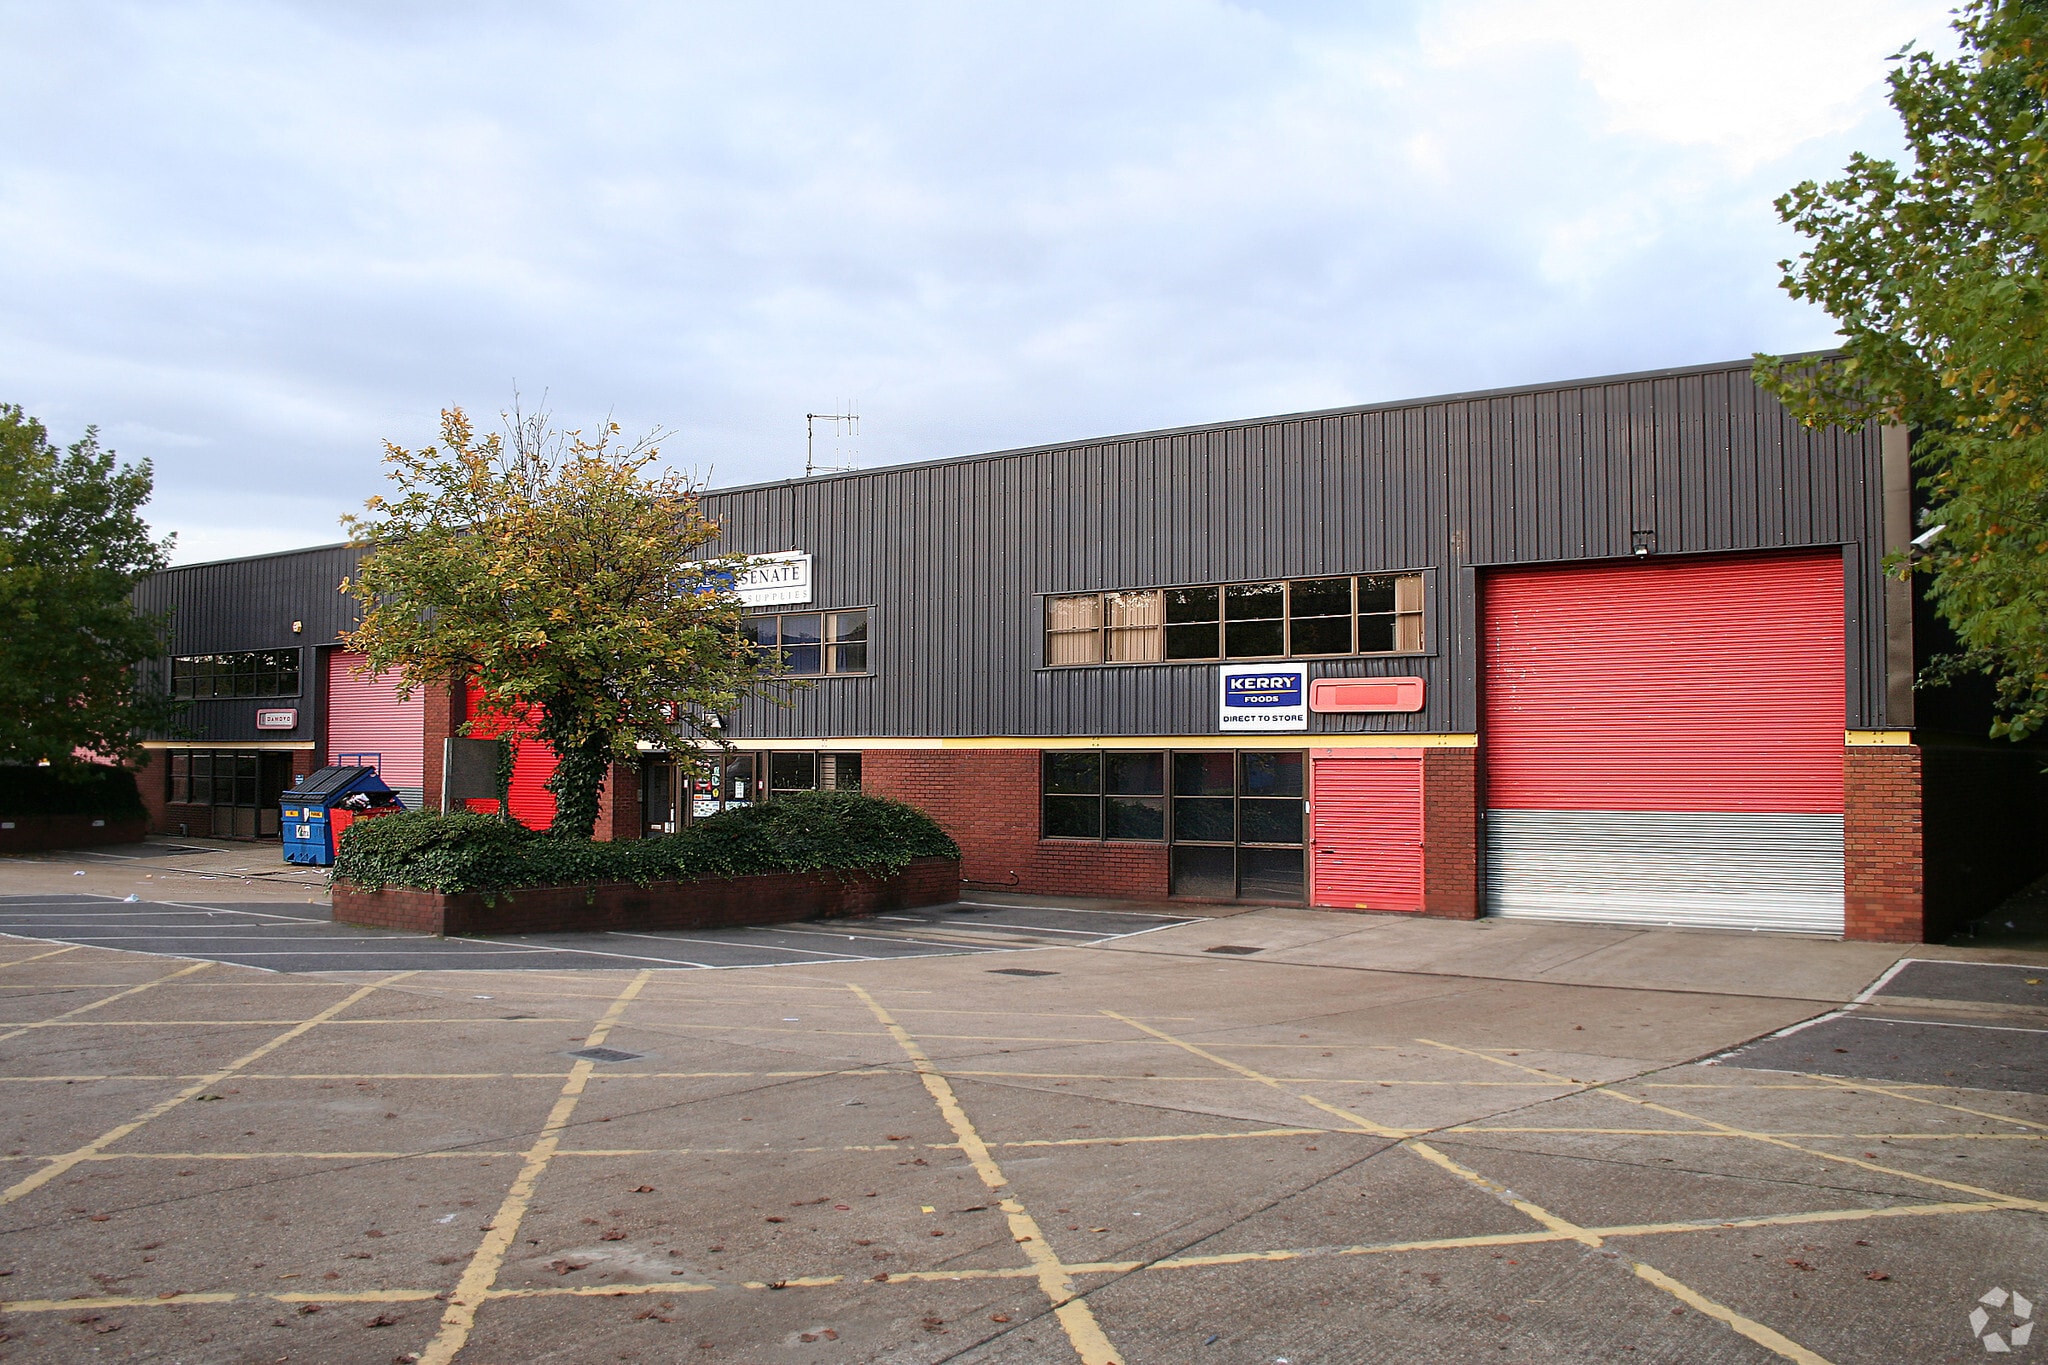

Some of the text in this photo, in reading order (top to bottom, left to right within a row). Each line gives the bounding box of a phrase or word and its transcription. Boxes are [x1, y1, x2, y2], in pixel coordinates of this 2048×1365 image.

[741, 566, 800, 586] SENATE
[747, 590, 808, 603] SUPPLIES
[1230, 676, 1297, 690] KERRY
[1244, 695, 1280, 703] FOODS
[1272, 714, 1304, 722] STORE
